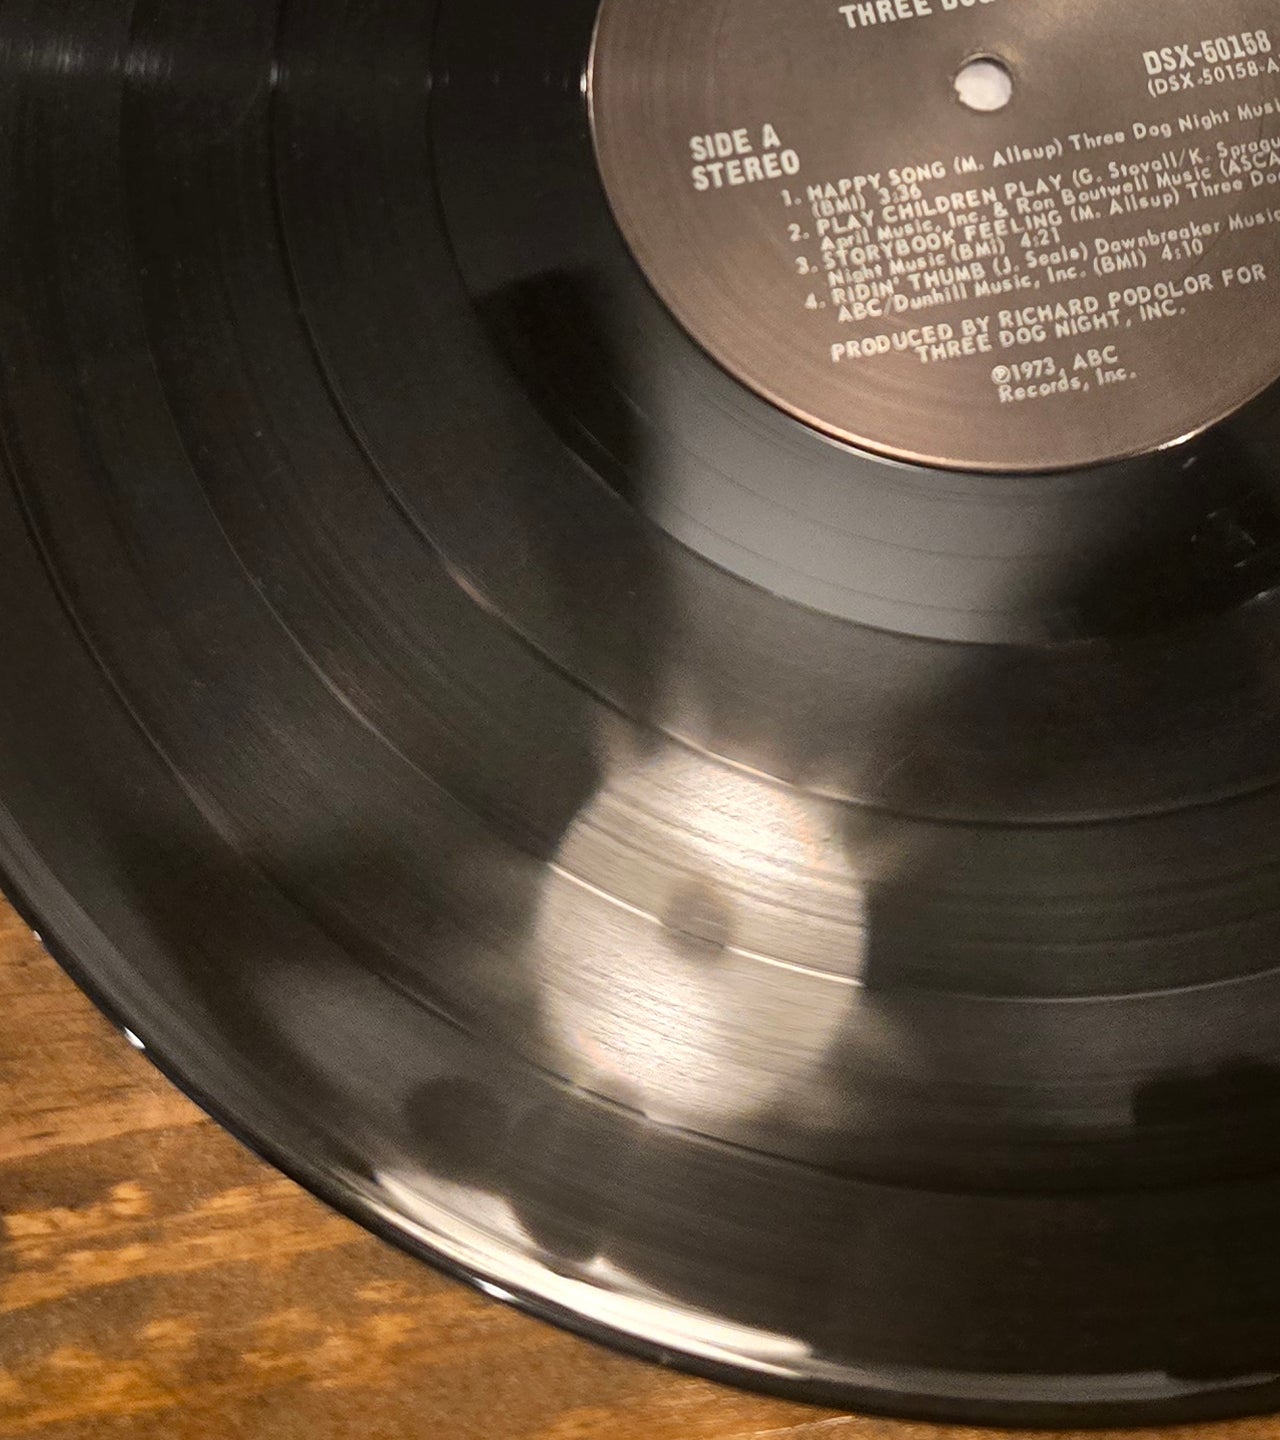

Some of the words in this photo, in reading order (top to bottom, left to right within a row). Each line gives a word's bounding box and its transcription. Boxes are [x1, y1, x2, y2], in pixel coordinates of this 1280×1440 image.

[1143, 30, 1272, 75] DSX-50158
[689, 128, 753, 161] SIDE
[762, 123, 781, 149] A
[691, 149, 801, 191] STEREO
[781, 189, 802, 208] 1.
[807, 173, 881, 202] HAPPY
[888, 161, 946, 187] SONG
[953, 155, 984, 174] (M.
[992, 137, 1063, 167] Allsup)
[1069, 131, 1125, 152] Three
[1133, 122, 1171, 140] Dog
[1178, 109, 1230, 133] Night
[787, 223, 810, 242] 2.
[816, 210, 874, 237] PLAY
[882, 187, 997, 223] CHILDREN
[1004, 174, 1063, 200] PLAY
[1072, 169, 1102, 188] (G.
[795, 256, 818, 275] 3.
[822, 230, 956, 271] STORYBOOK
[964, 209, 1063, 241] FEELING
[1071, 205, 1101, 223] (M.
[1109, 186, 1180, 215] Allsup)
[1186, 178, 1243, 199] Three
[812, 192, 867, 219] (BMI)
[877, 184, 922, 205] 3:36
[822, 227, 870, 251] April
[947, 210, 987, 228] Inc.
[993, 200, 1009, 218] &
[1016, 195, 1055, 213] Ron
[1061, 177, 1149, 206] Boutwell
[1156, 166, 1212, 188] Music
[805, 292, 825, 310] 4.
[909, 262, 985, 290] THUMB
[992, 256, 1019, 278] (J.
[1025, 242, 1088, 268] Seals)
[1095, 219, 1221, 254] Dawnbreaker
[828, 264, 882, 287] Night
[889, 252, 946, 275] Music
[950, 237, 1006, 262] (BMI)
[1020, 227, 1061, 248] 4:21
[838, 282, 968, 323] ABC/Dunhill
[974, 277, 1040, 298] Music,
[1047, 265, 1086, 283] Inc.
[1093, 248, 1147, 277] (BMI)
[1161, 238, 1205, 261] 4:10
[831, 323, 954, 363] PRODUCED
[961, 316, 990, 337] BY
[998, 295, 1100, 329] RICHARD
[1108, 272, 1214, 307] PODOLOR
[1222, 263, 1267, 287] FOR
[915, 333, 992, 364] THREE
[999, 325, 1047, 348] DOG
[1139, 298, 1186, 322] INC.
[999, 374, 1089, 403] Records,
[1095, 367, 1136, 386] Inc.
[1072, 345, 1118, 372] ABC
